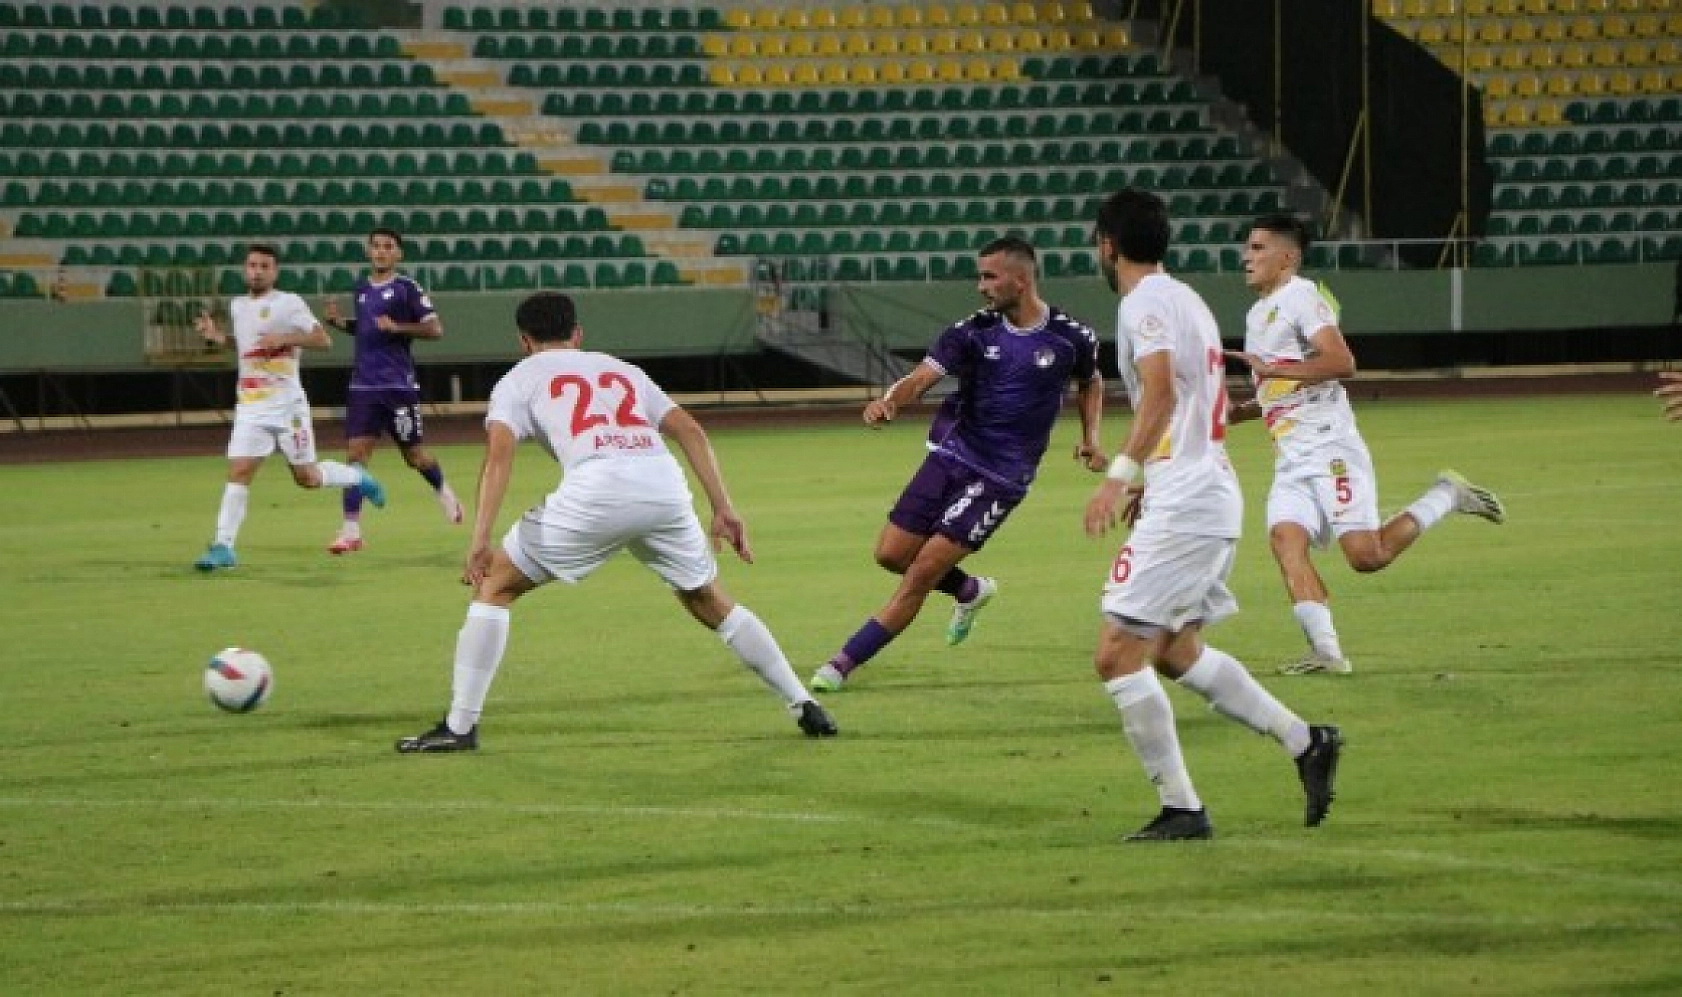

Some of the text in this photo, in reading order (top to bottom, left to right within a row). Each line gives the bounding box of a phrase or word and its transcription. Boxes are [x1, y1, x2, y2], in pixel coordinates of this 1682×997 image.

[549, 372, 648, 437] 22
[1335, 476, 1353, 505] 5
[1112, 546, 1133, 584] 6
